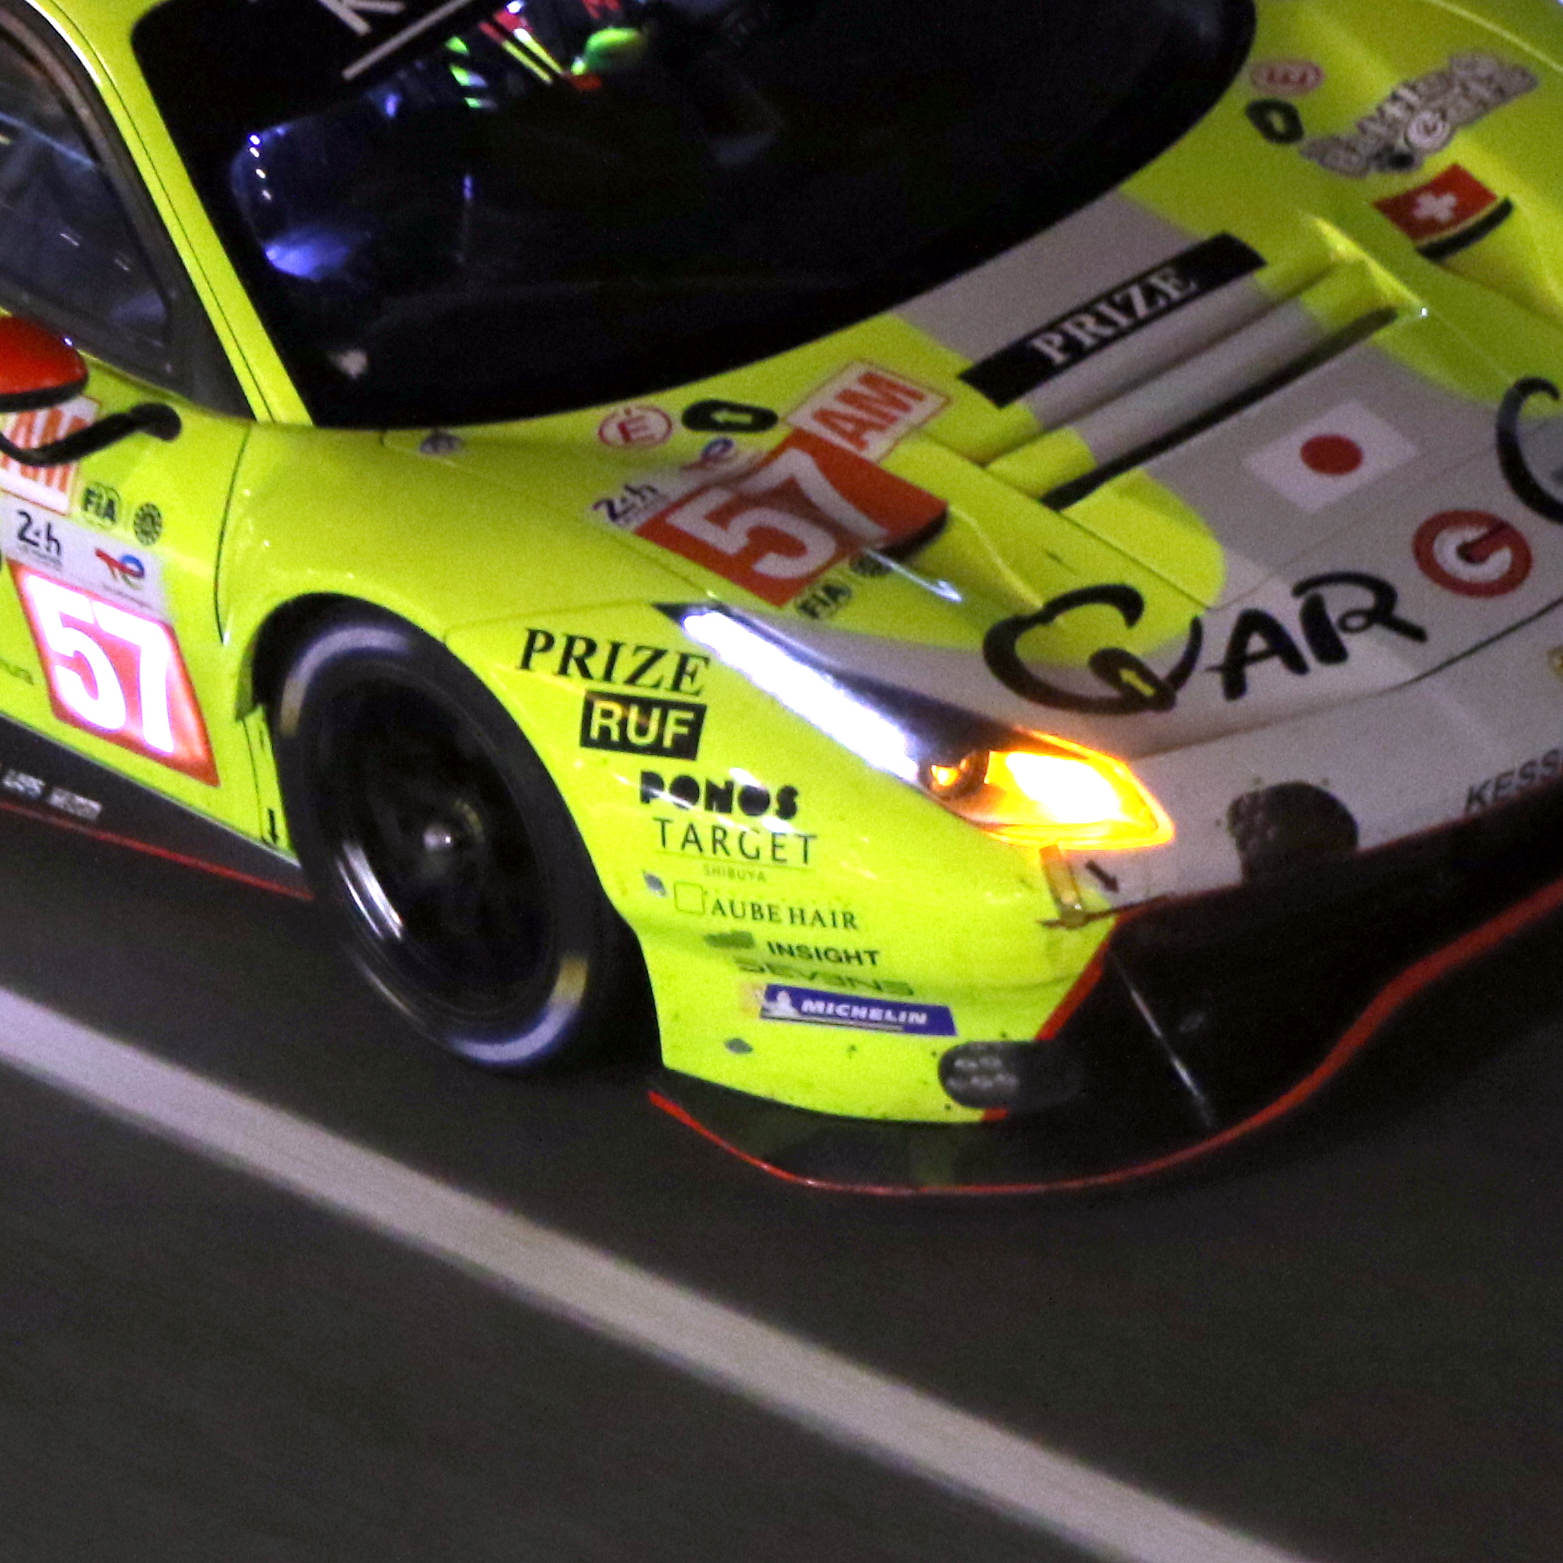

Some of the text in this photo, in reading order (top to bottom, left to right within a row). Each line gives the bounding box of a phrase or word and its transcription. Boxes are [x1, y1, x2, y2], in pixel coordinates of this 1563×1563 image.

[1029, 265, 1198, 366] PRIZE
[812, 371, 926, 452] AM
[83, 486, 118, 524] FIA
[665, 447, 891, 580] 57
[22, 571, 175, 755] 57
[518, 626, 712, 698] PRIZE
[982, 570, 1428, 715] CAR
[590, 699, 696, 749] RUF
[639, 770, 799, 821] PONOS
[653, 816, 818, 866] TARGET
[703, 862, 768, 883] SHIBUYA
[710, 897, 859, 930] AUBE HAIR
[766, 940, 880, 966] INSIGHT
[800, 998, 929, 1025] MICHELIN
